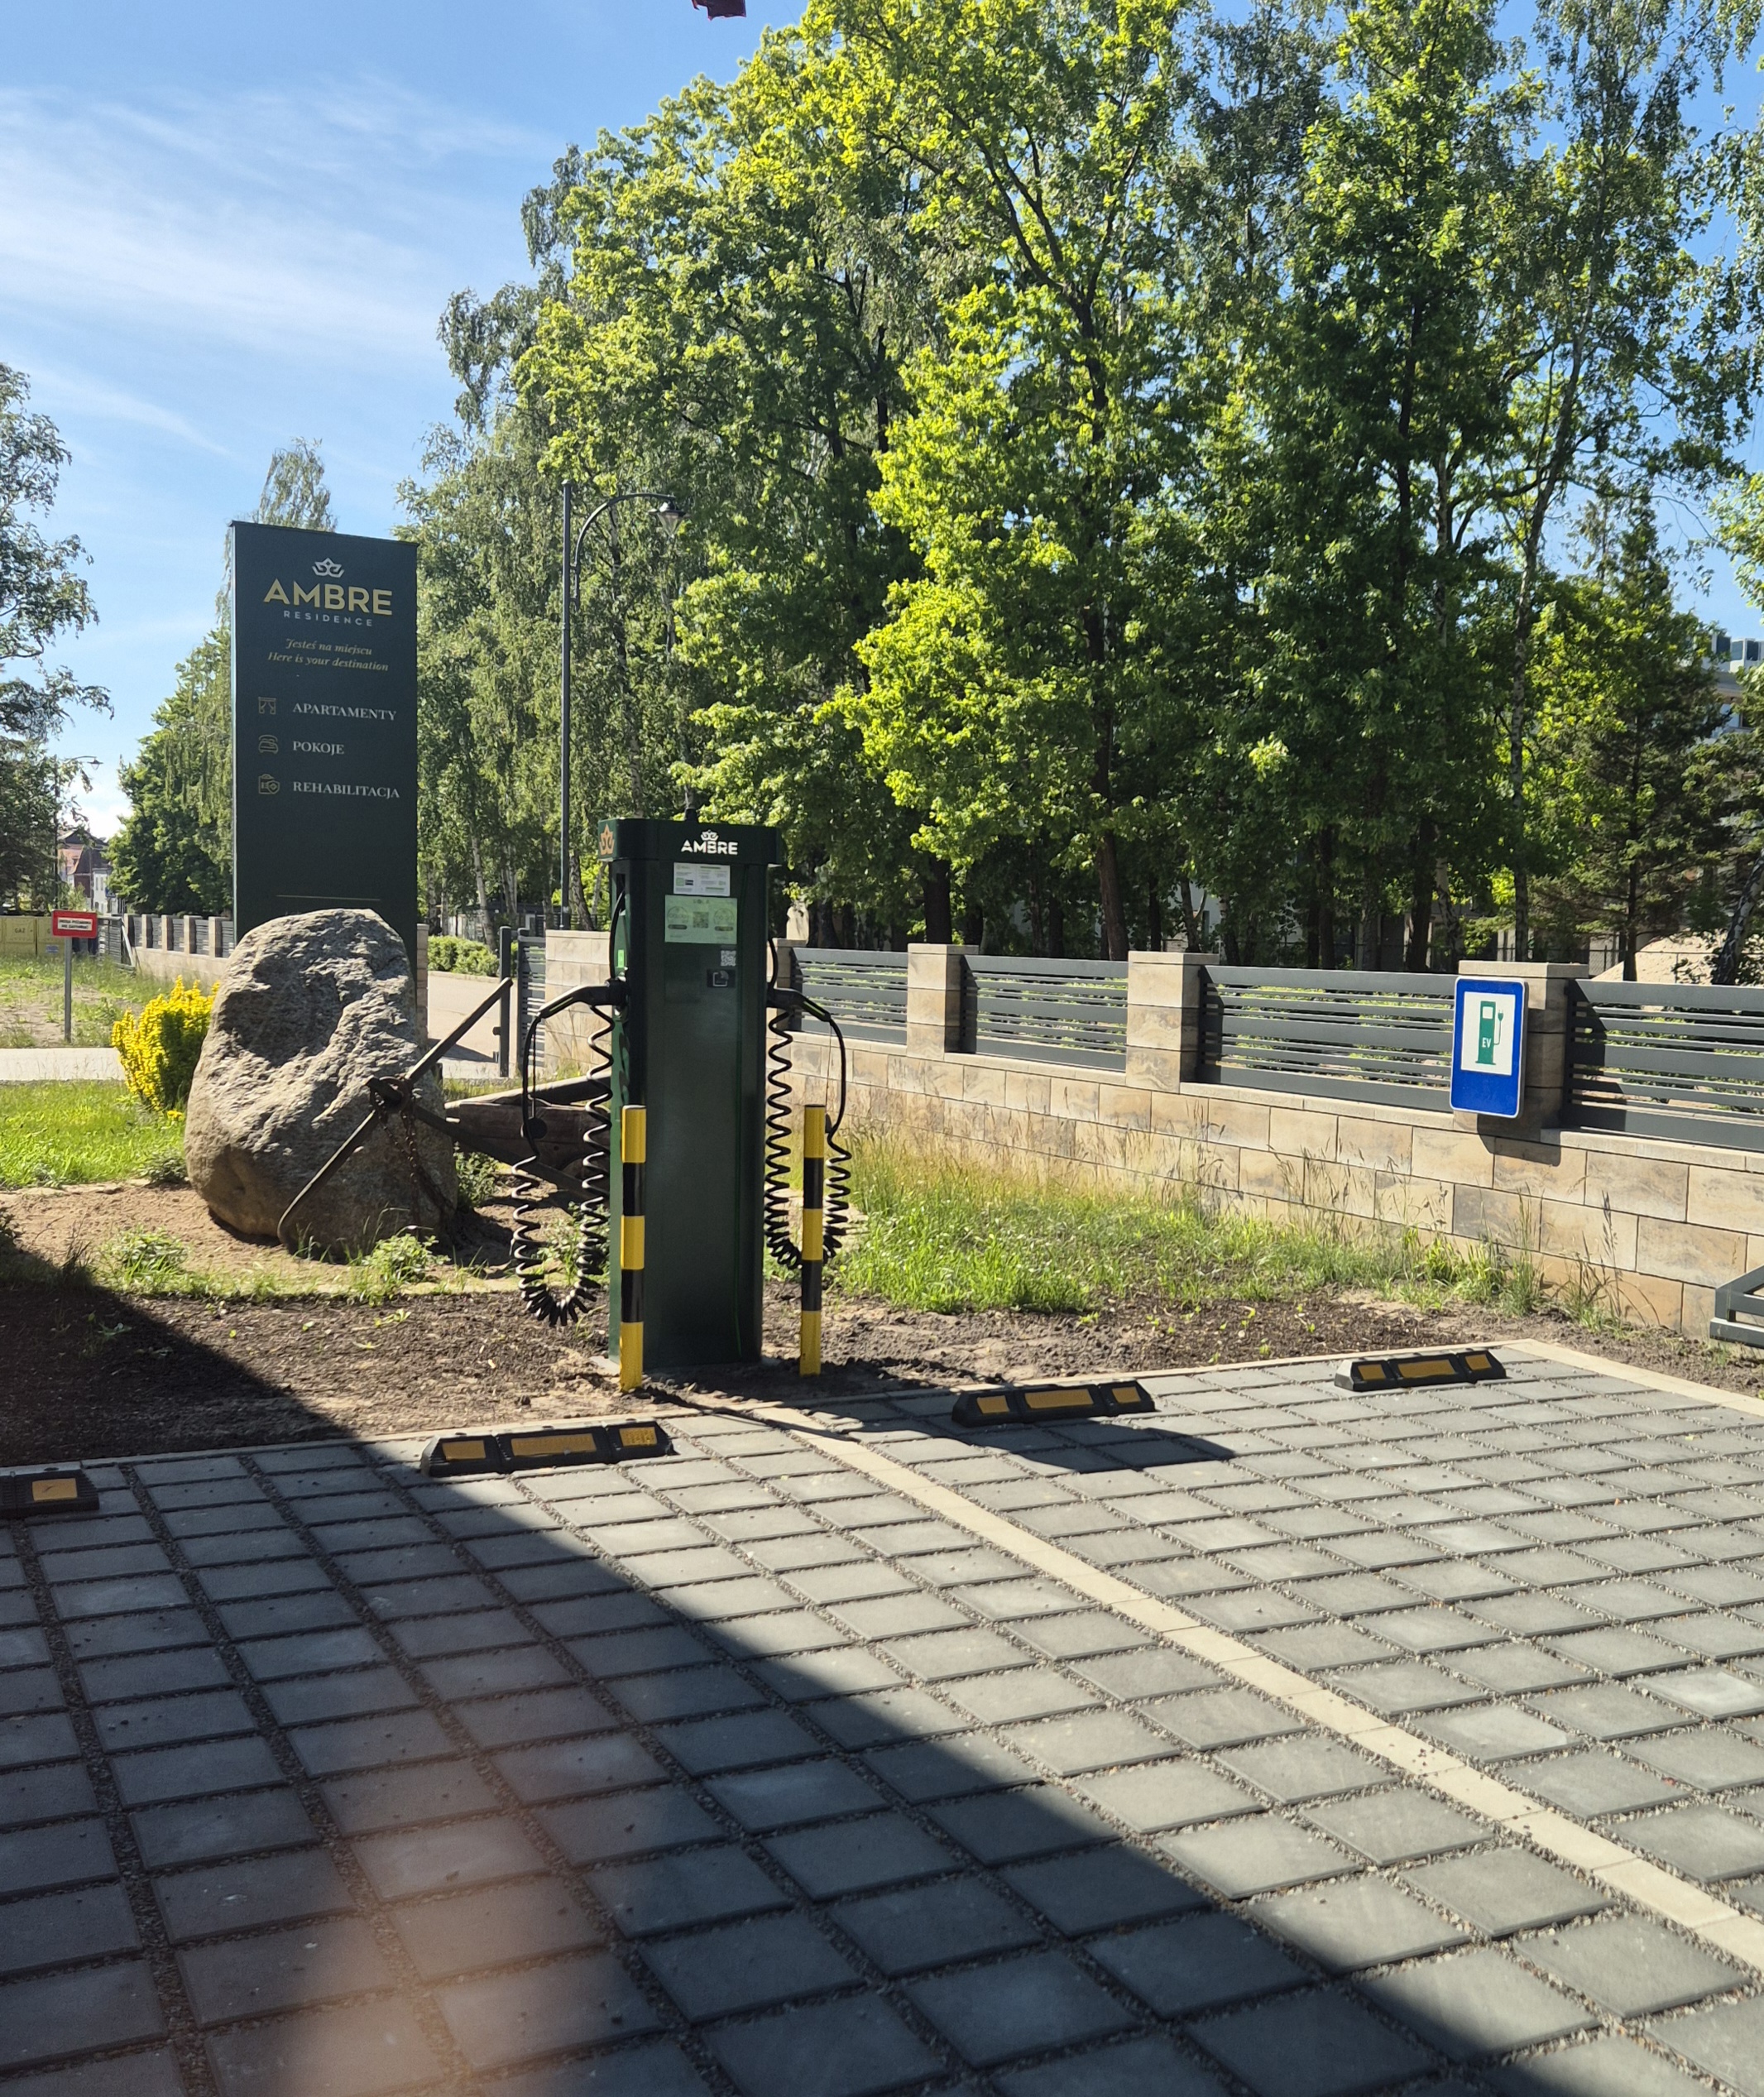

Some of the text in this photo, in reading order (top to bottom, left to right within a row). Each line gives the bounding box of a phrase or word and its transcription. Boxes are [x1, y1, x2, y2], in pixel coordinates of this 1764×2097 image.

[263, 578, 393, 616] AMBRE
[283, 610, 373, 627] RESIDENCE
[285, 638, 373, 655] Jesteś na miejscu
[267, 651, 390, 672] Here is your destination
[292, 703, 397, 721] APARTAMENTY
[292, 741, 345, 756] POKOJE
[292, 781, 400, 800] REHABILITACJA
[681, 839, 738, 855] AMBRE
[1481, 1036, 1493, 1048] EV
